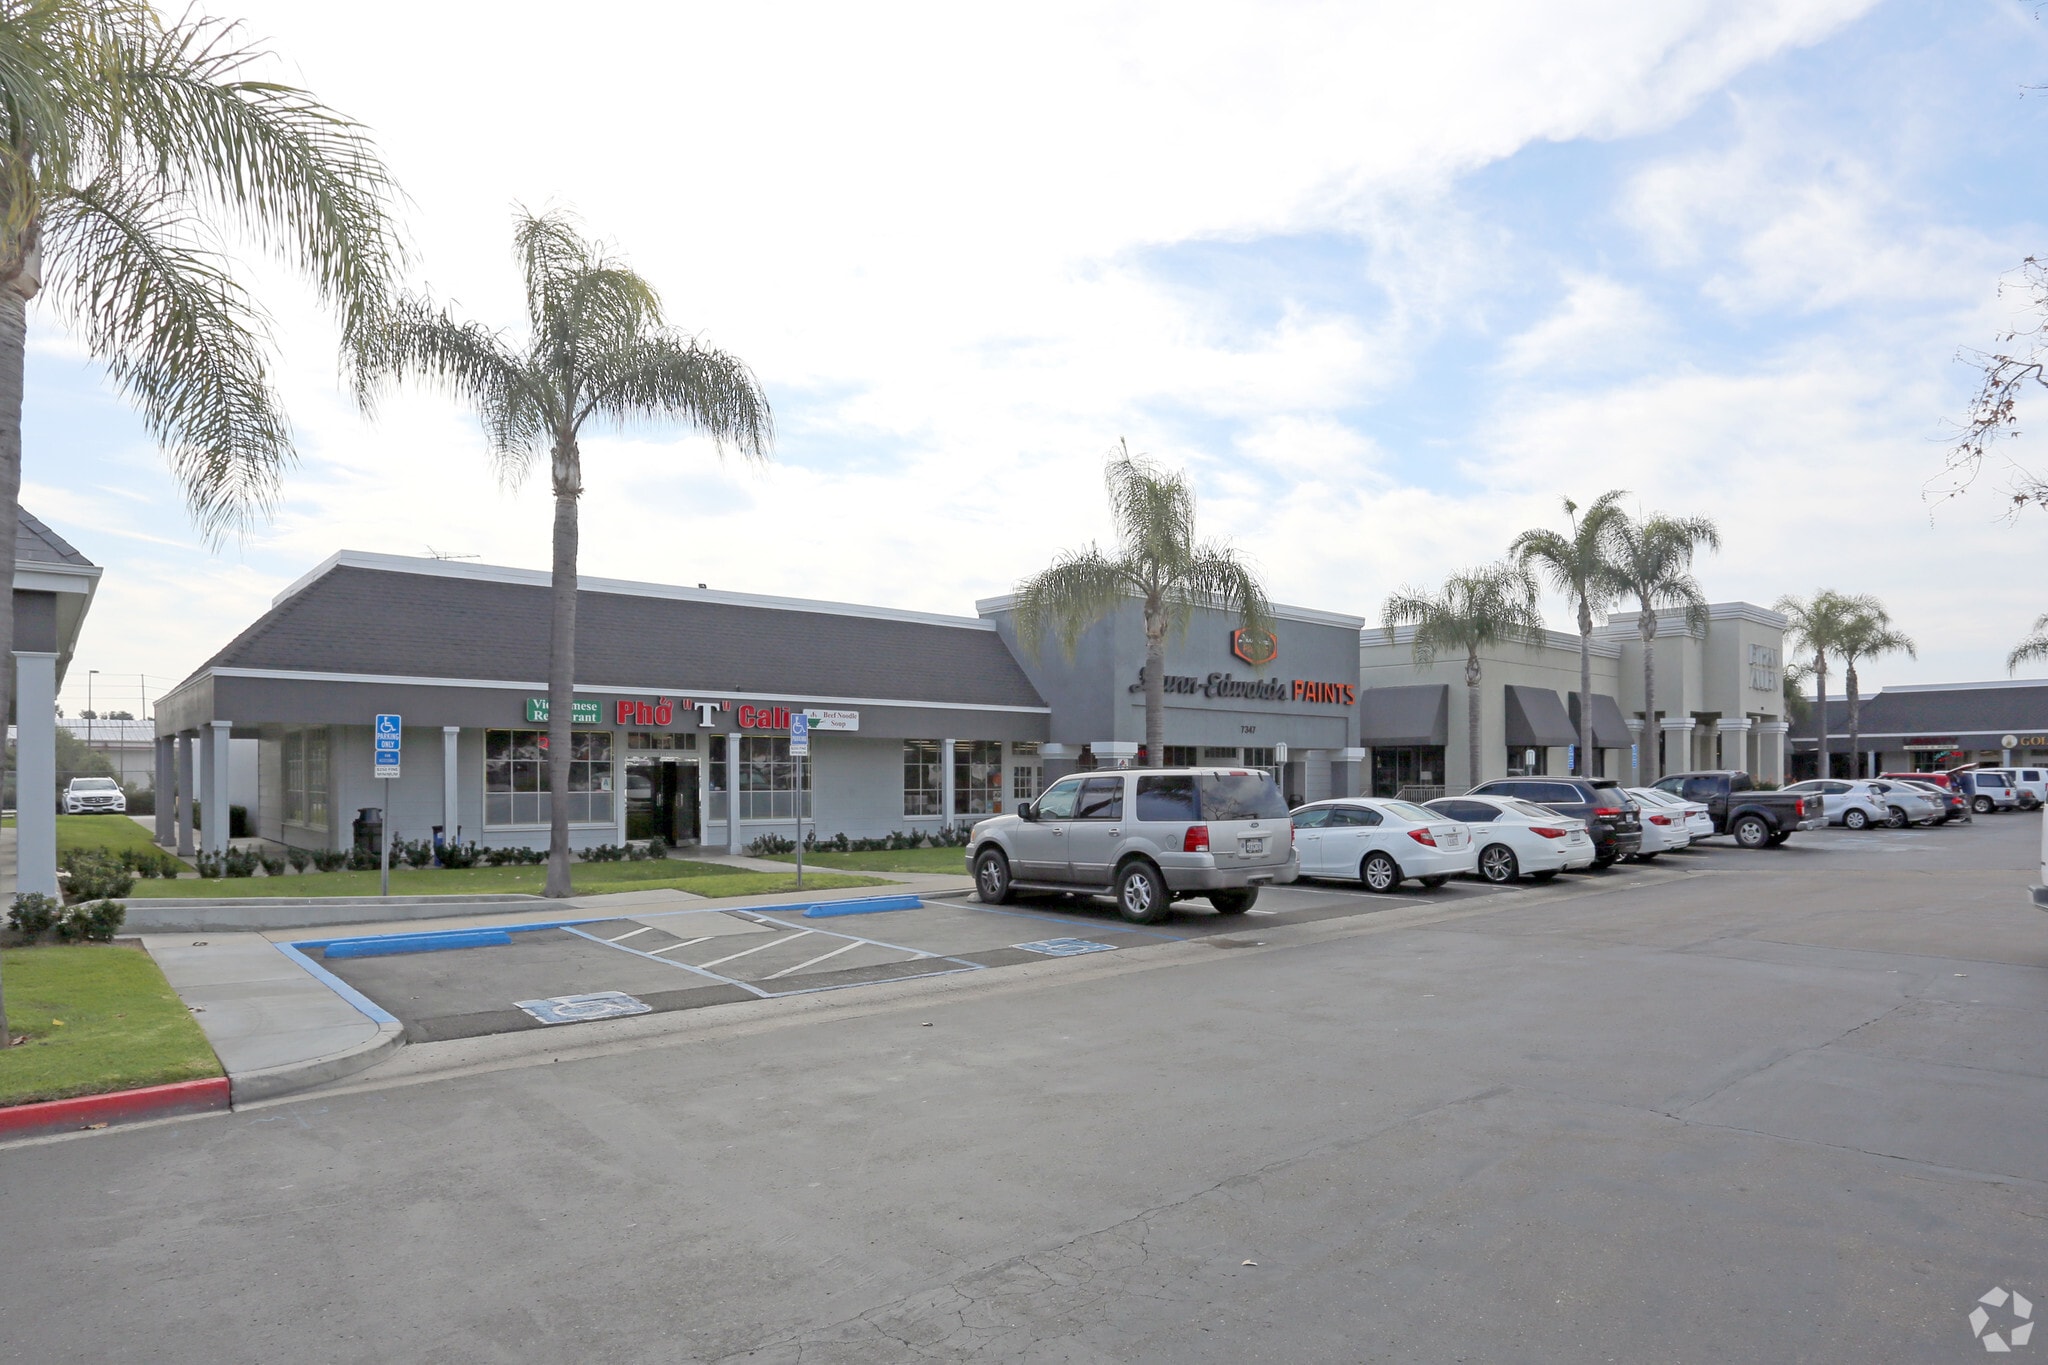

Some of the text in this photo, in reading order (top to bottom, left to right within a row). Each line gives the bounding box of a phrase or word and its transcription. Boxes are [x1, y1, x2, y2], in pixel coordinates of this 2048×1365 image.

[1294, 680, 1355, 705] PAINTS
[533, 699, 597, 711] Vimese
[534, 710, 597, 722] Rerant
[738, 704, 790, 729] Cali
[823, 711, 857, 720] Beef Noodle
[831, 720, 847, 728] Soup
